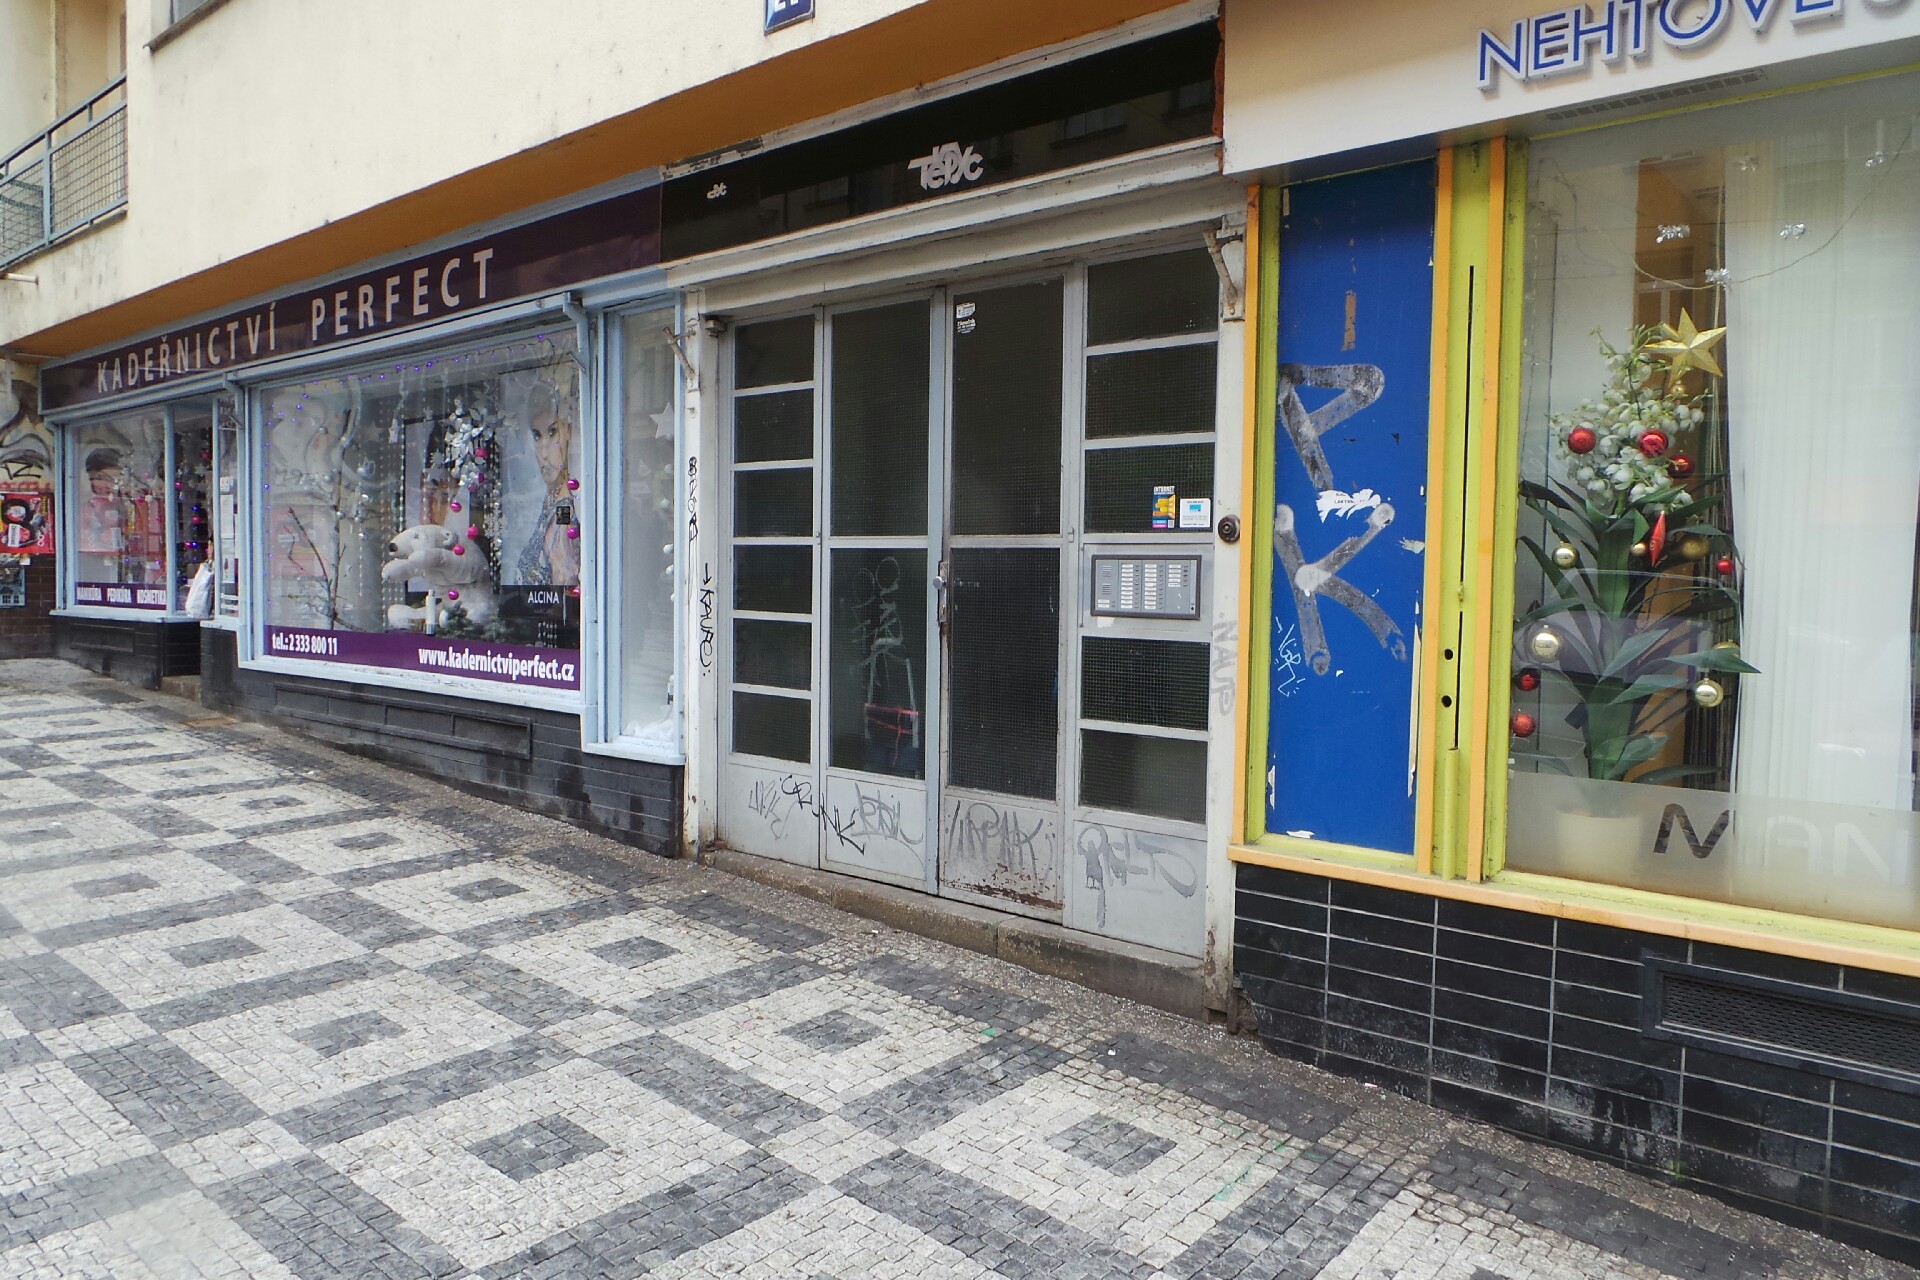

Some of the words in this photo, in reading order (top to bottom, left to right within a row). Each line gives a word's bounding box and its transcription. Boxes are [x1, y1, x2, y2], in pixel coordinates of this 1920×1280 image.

[1477, 0, 1844, 92] NEHTO
[97, 301, 276, 394] KADEŘNICTVÍ
[312, 248, 494, 341] PERFECT
[527, 591, 560, 604] ALCINA
[272, 632, 288, 651] tel.:
[418, 646, 575, 682] www.kadernictviperfect.cz
